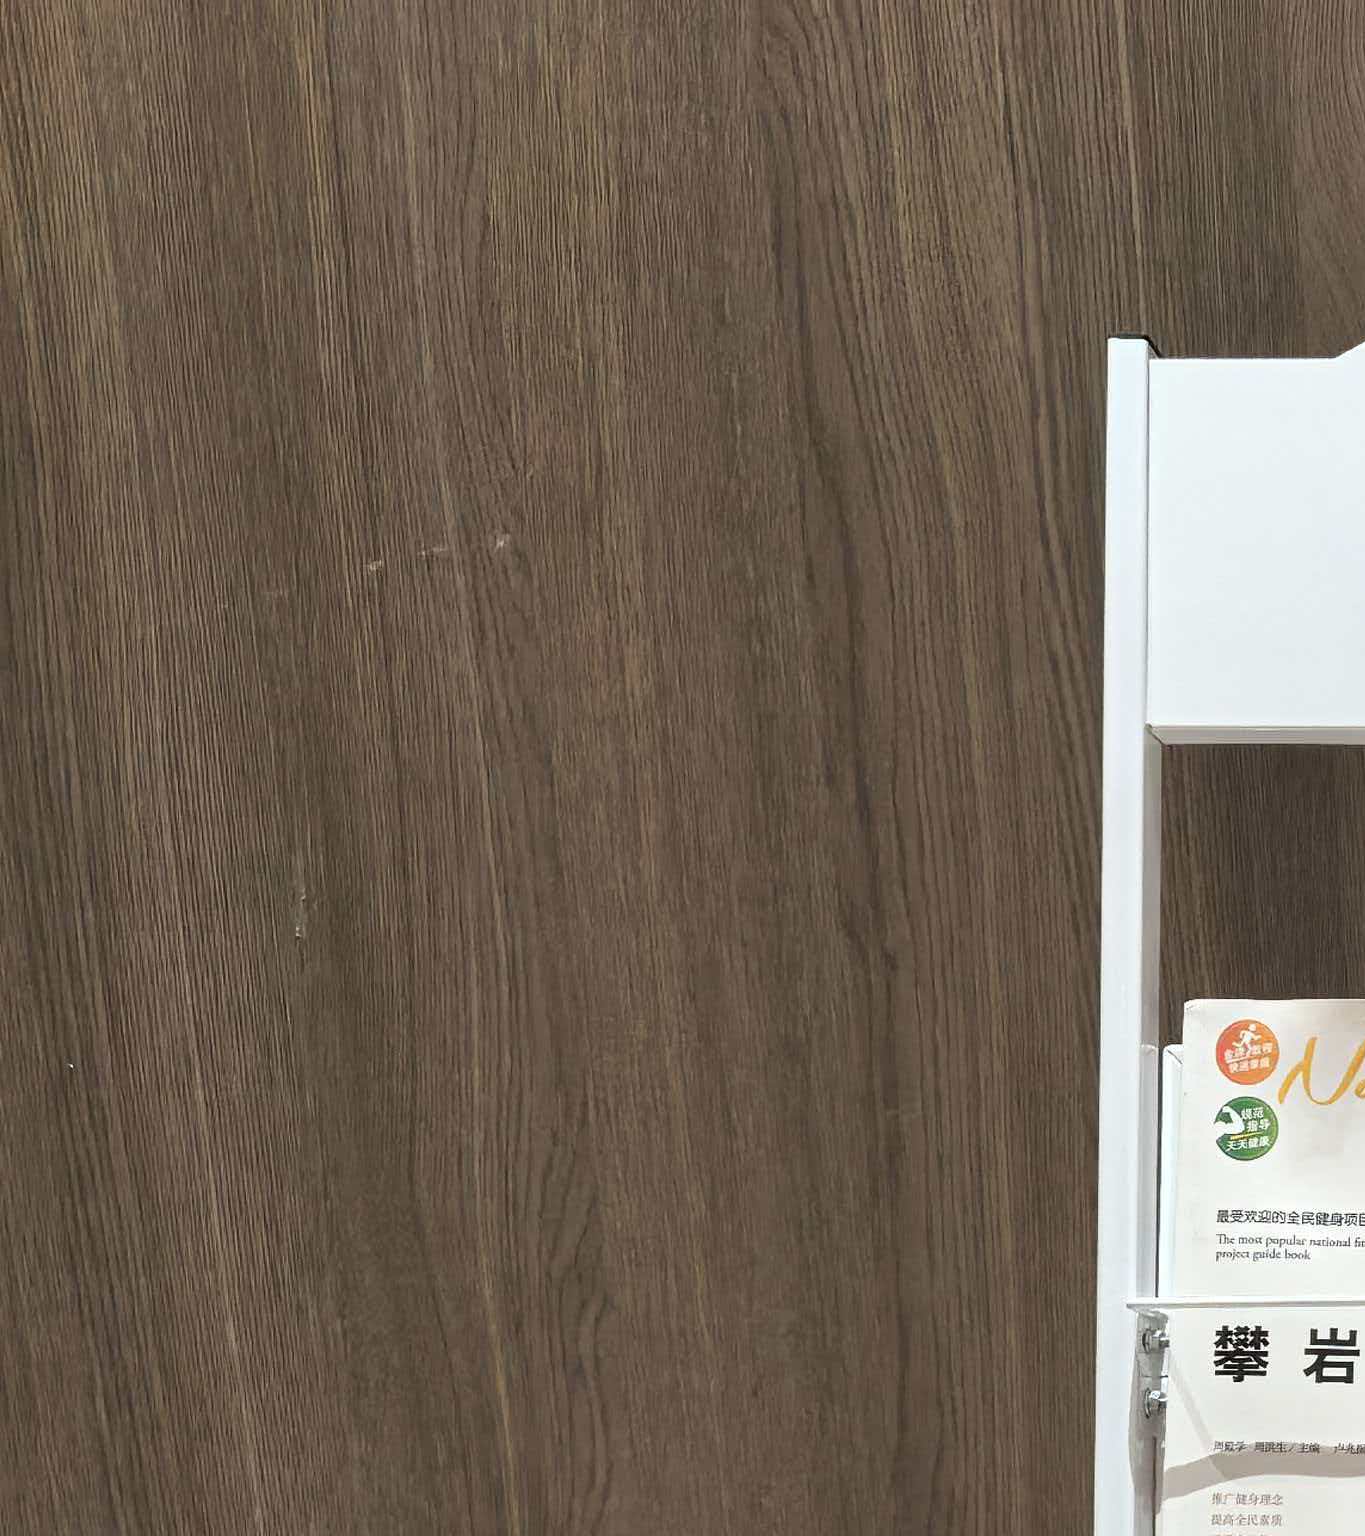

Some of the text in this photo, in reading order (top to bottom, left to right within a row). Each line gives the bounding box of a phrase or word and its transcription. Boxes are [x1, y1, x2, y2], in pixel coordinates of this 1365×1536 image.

[1216, 1234, 1235, 1246] The
[1238, 1236, 1263, 1247] most
[1265, 1235, 1307, 1251] popular
[1309, 1236, 1351, 1248] national
[1215, 1249, 1311, 1263] project guide book
[1213, 1324, 1361, 1384] 攀岩
